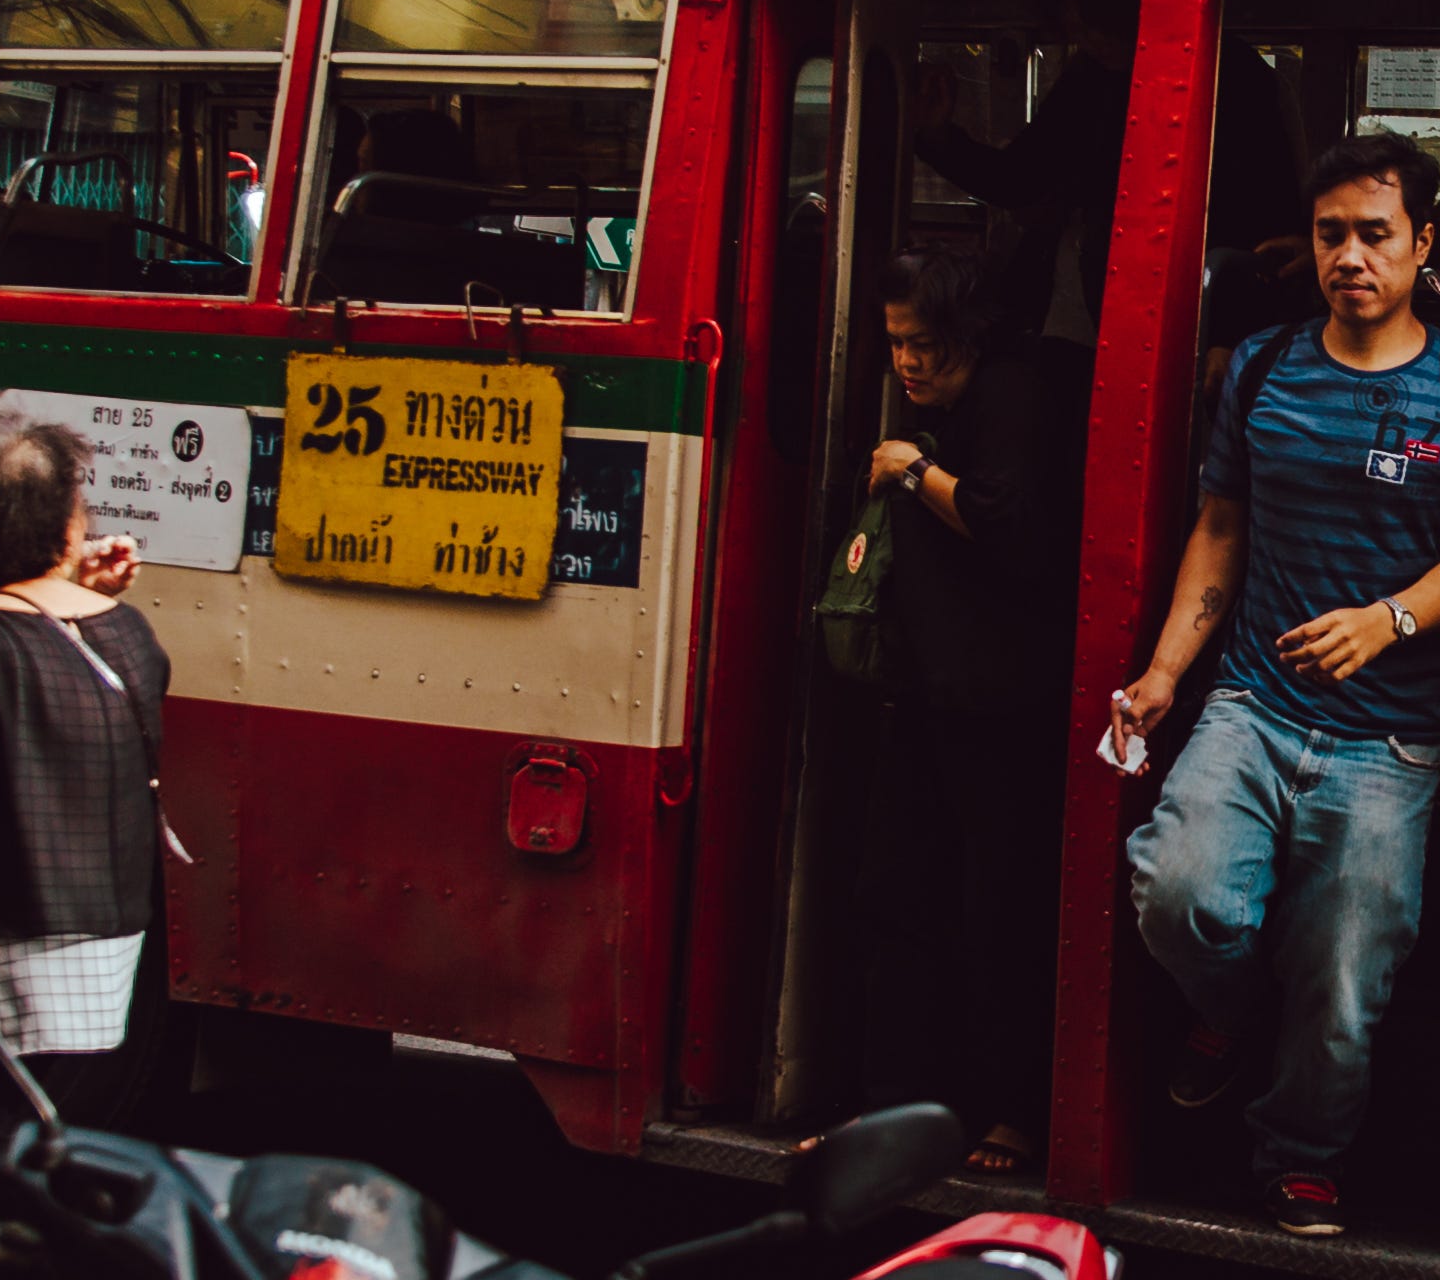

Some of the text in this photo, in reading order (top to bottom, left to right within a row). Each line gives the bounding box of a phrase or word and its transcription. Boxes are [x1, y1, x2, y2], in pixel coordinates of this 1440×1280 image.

[92, 405, 154, 428] สาย 25
[301, 374, 533, 456] 25 ทางด่วน
[173, 425, 200, 456] ฟรี
[110, 471, 152, 492] จอดรับ
[382, 453, 544, 497] EXPRESSWAY
[303, 513, 526, 578] ปากน้ำ ท่าช้าง
